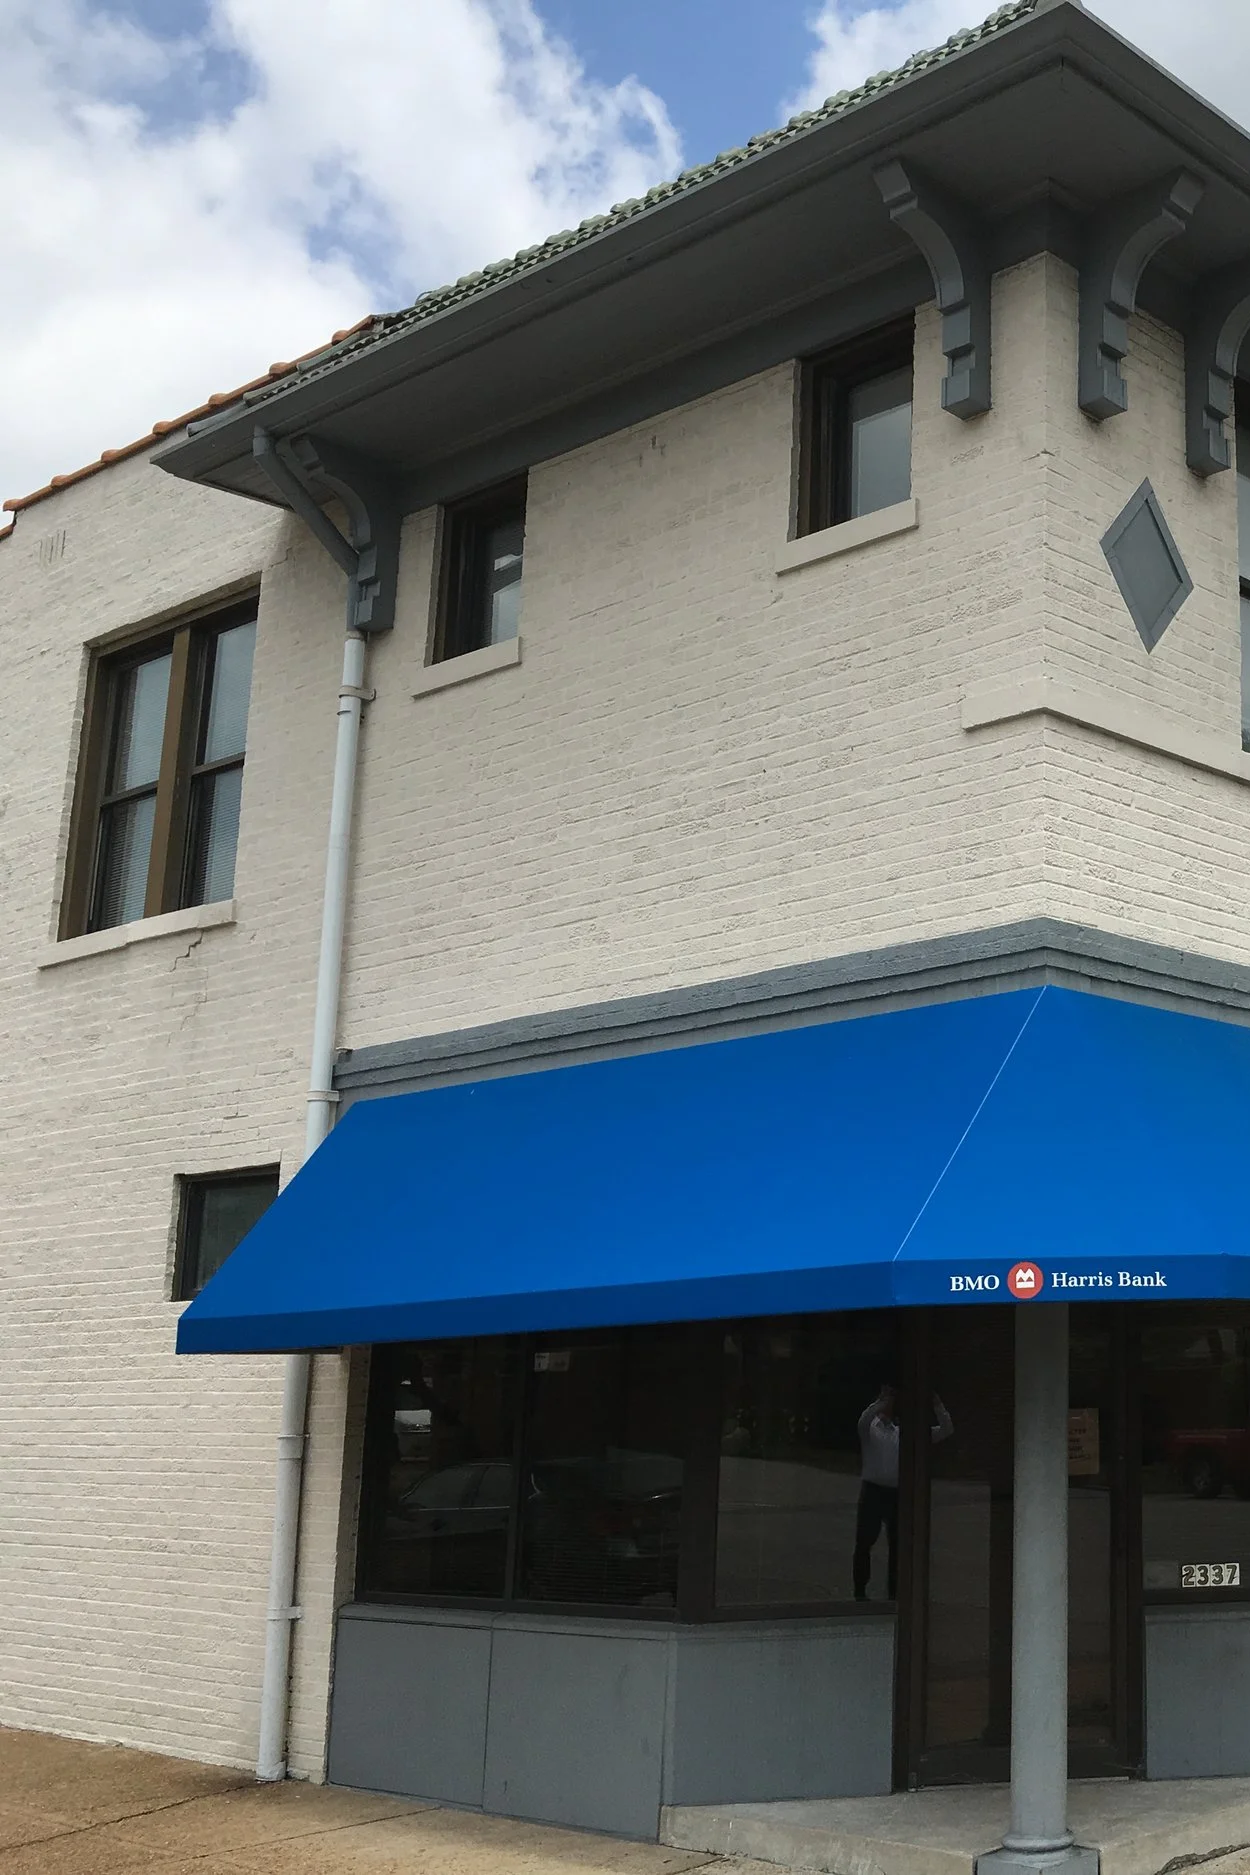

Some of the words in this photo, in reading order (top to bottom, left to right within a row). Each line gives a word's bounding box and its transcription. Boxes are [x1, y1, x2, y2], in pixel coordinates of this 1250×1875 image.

[950, 1275, 1000, 1291] BMO
[1052, 1272, 1113, 1288] Harris
[1118, 1271, 1167, 1287] Bank
[1183, 1565, 1238, 1586] 2337
